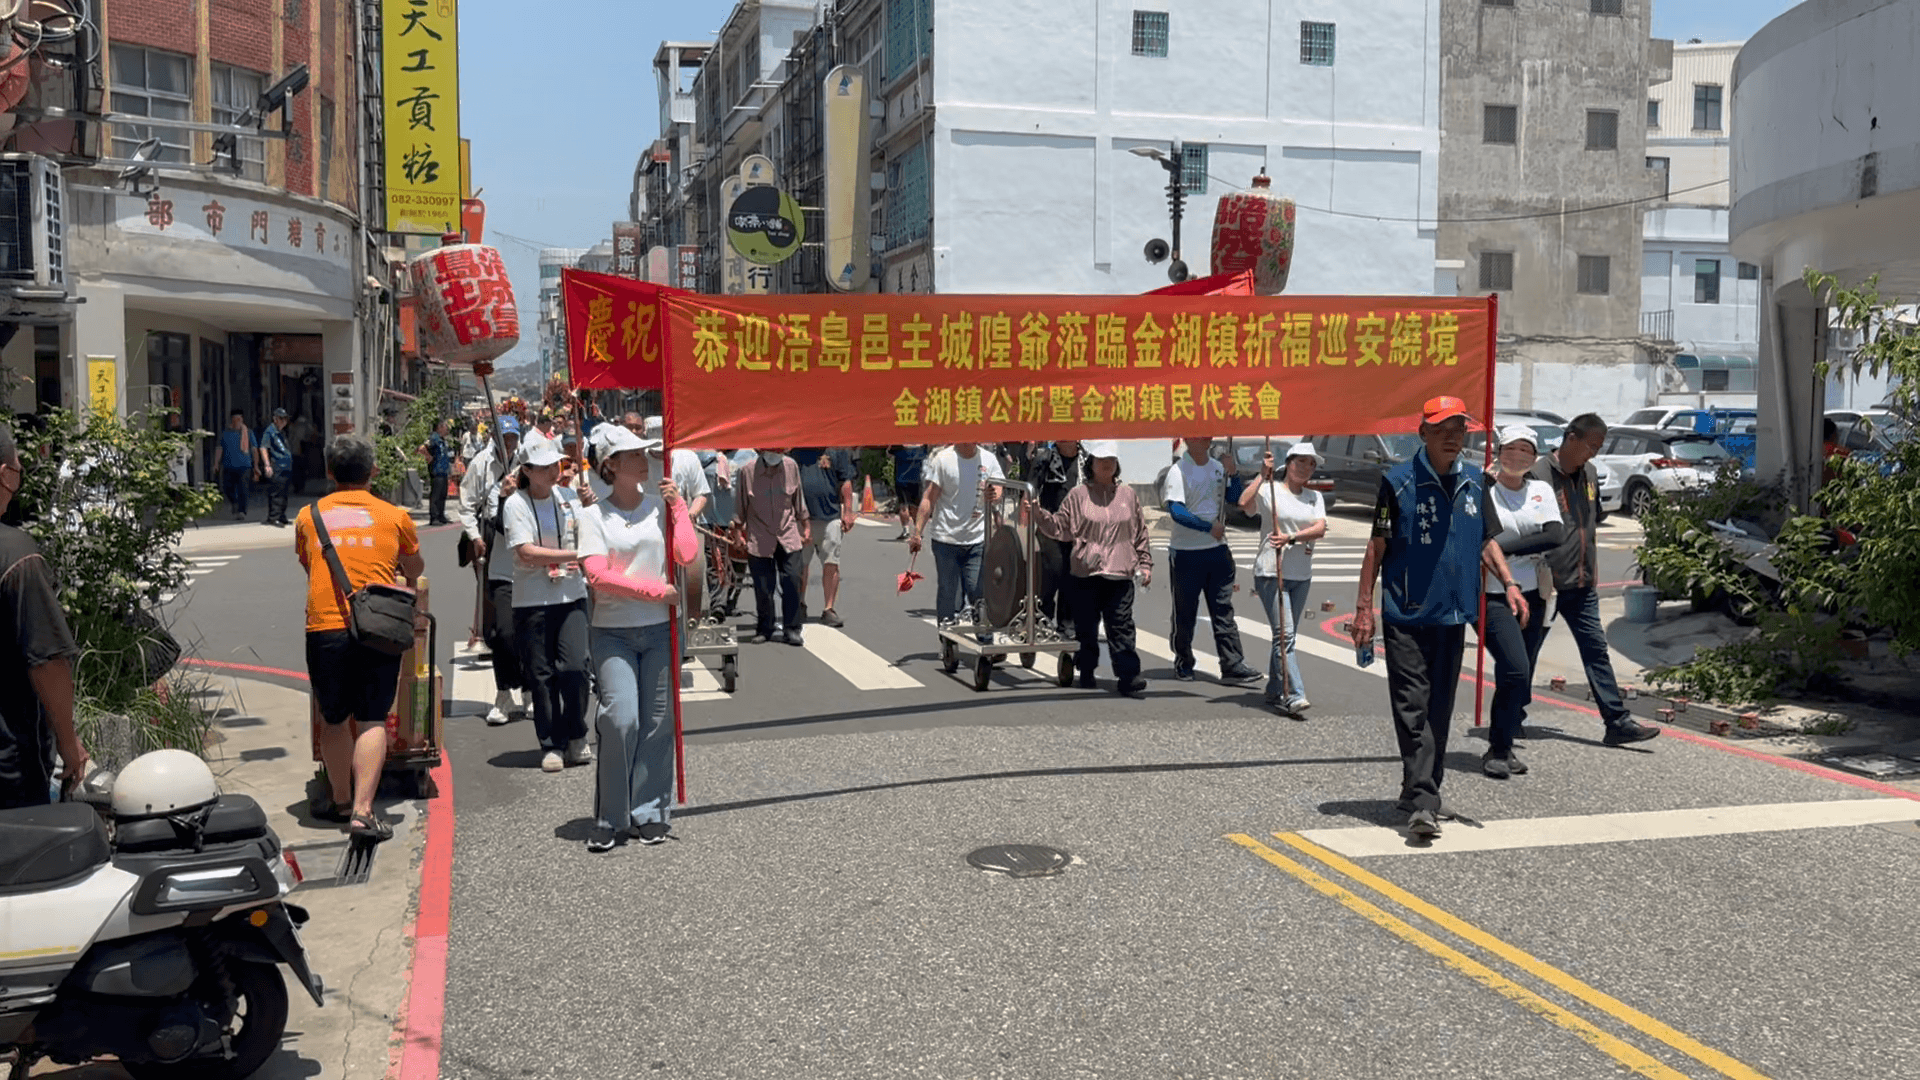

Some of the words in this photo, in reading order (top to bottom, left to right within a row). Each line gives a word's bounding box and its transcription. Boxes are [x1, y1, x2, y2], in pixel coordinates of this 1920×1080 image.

[396, 0, 443, 185] 天工貢糖
[391, 194, 455, 206] 082-330997
[583, 293, 660, 364] 慶祝
[893, 380, 1282, 427] 金湖鎮公所暨金湖鎮民代表會
